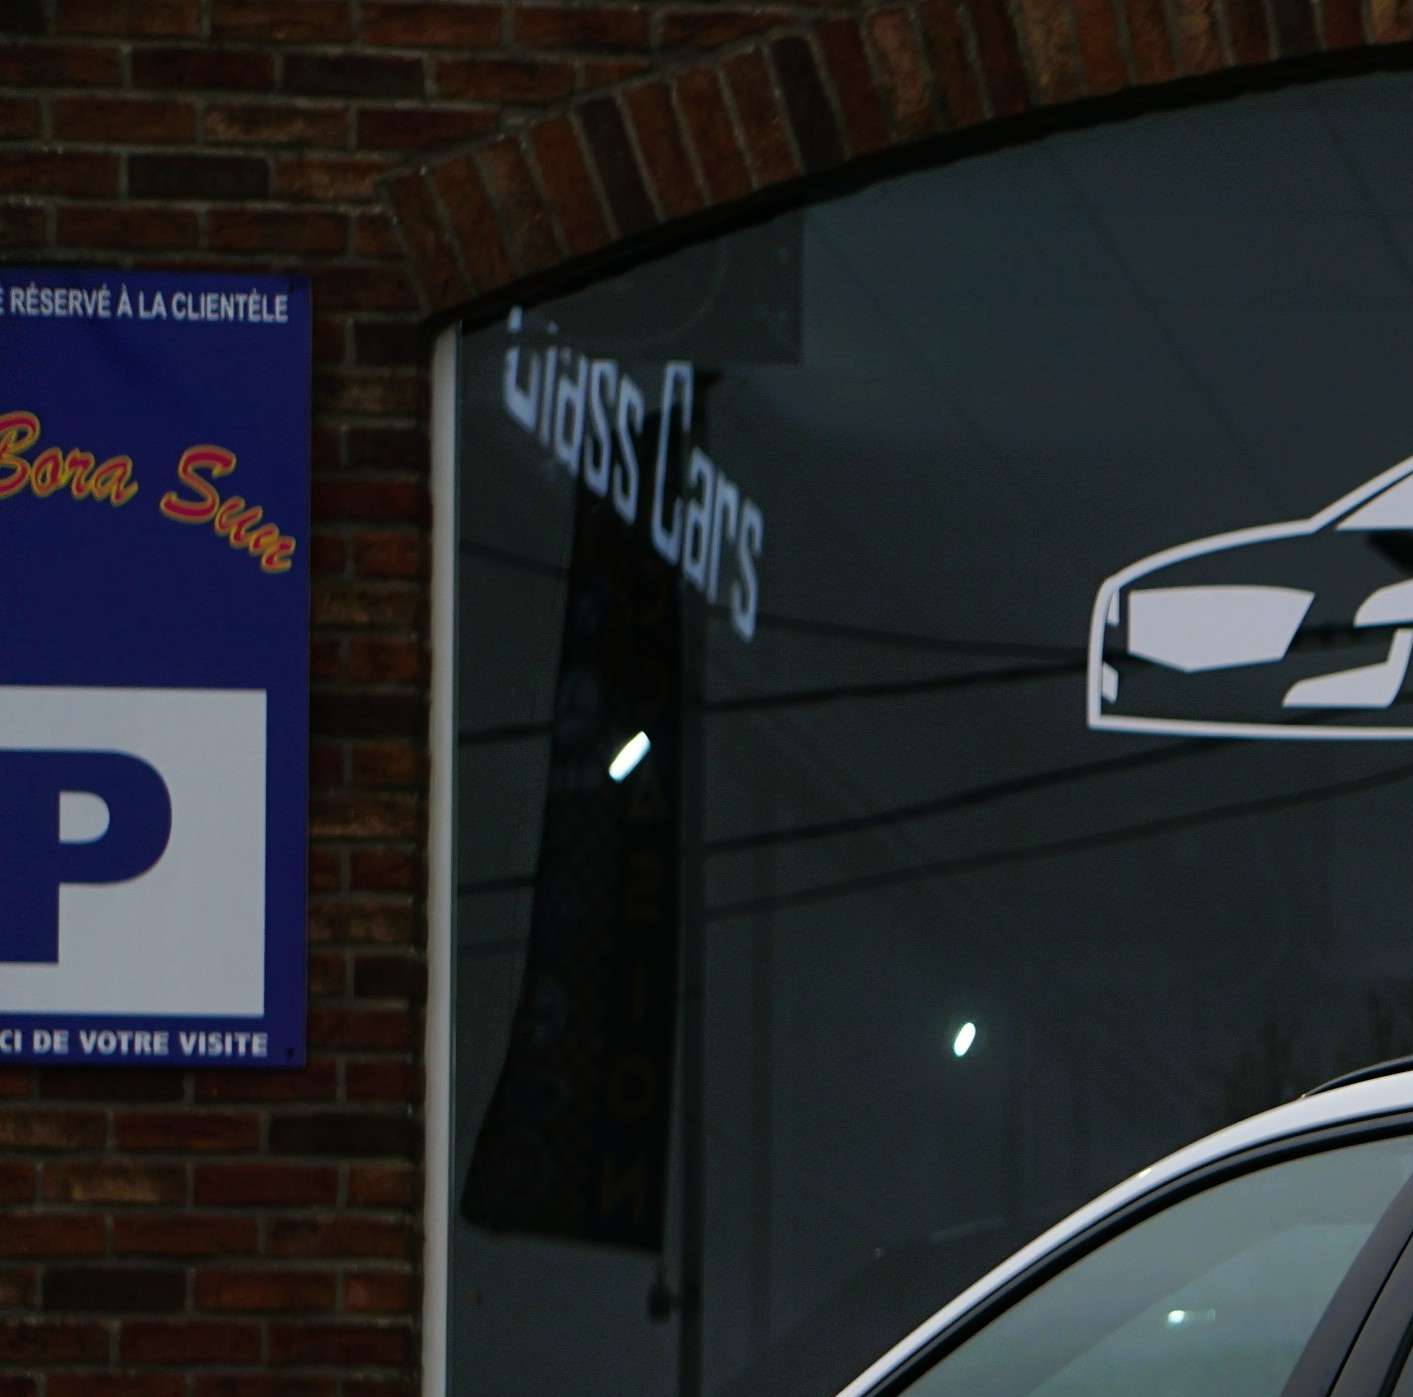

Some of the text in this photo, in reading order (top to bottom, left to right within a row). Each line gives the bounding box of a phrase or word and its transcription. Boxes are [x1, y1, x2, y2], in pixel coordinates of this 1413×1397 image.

[10, 281, 111, 318] RÉSERVÉ
[116, 284, 133, 318] À
[139, 293, 167, 320] LA
[173, 288, 288, 323] CLIENTÈLE
[0, 411, 296, 573] Bora Sun
[651, 361, 764, 642] Cars
[0, 748, 172, 964] P
[33, 1030, 69, 1053] DE
[80, 1030, 169, 1055] VOTRE
[179, 1031, 268, 1057] VISITE
